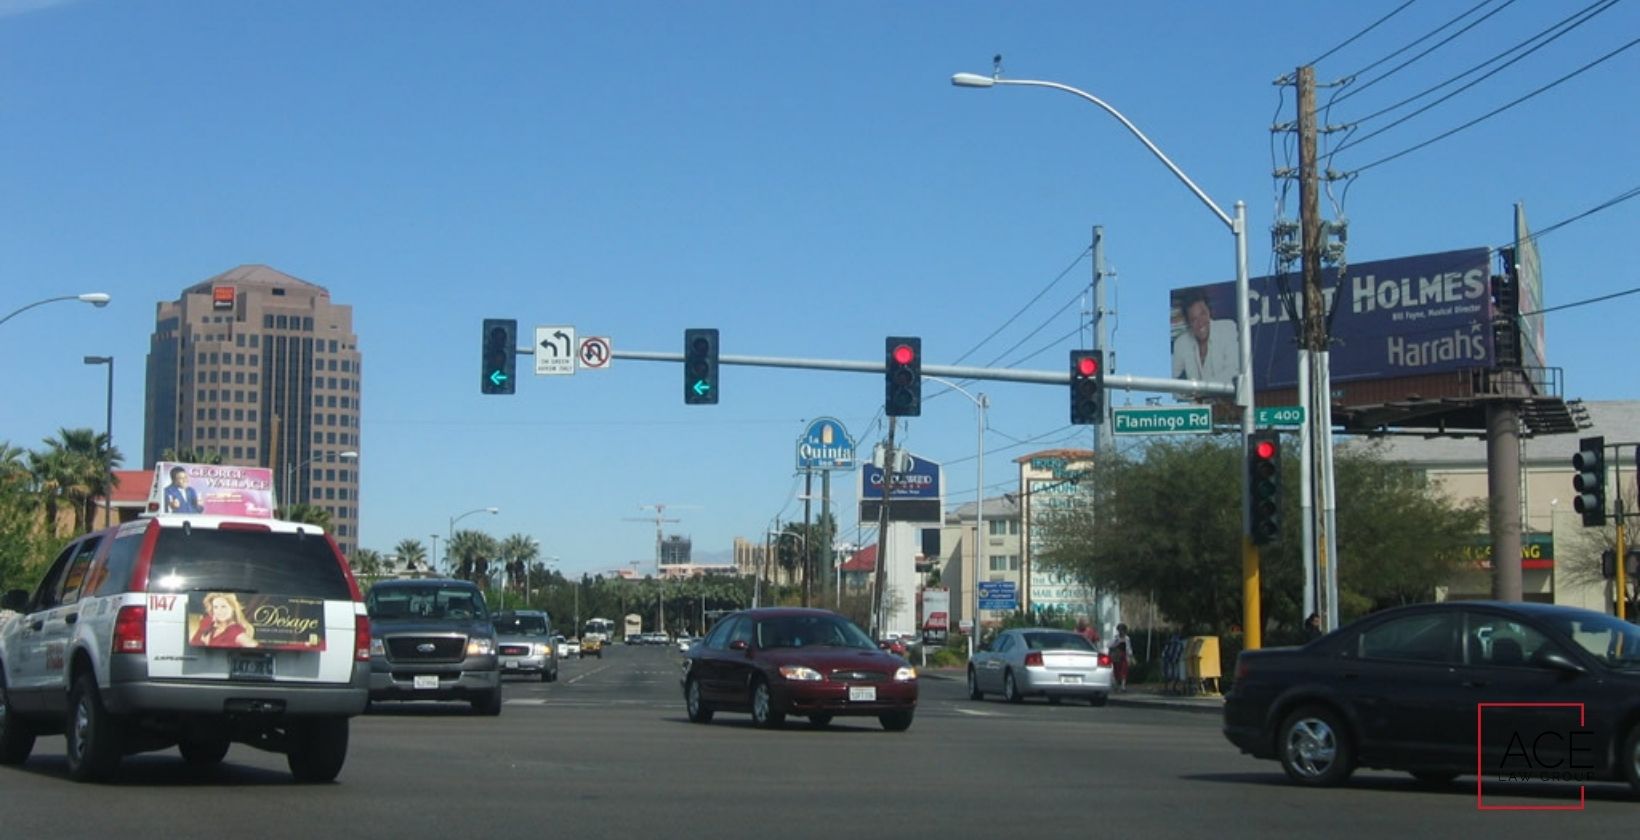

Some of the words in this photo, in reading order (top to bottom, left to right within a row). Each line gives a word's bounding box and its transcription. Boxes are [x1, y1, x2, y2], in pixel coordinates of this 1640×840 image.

[1352, 269, 1485, 313] HOLMES
[1116, 414, 1185, 430] Flamingo
[1189, 413, 1209, 426] Rd
[1259, 411, 1268, 422] E
[1274, 410, 1300, 421] 400
[800, 442, 852, 460] Quinta
[190, 467, 247, 480] GEORGE
[206, 478, 271, 491] WALLACE
[149, 596, 177, 611] 1147
[253, 605, 320, 634] Desage
